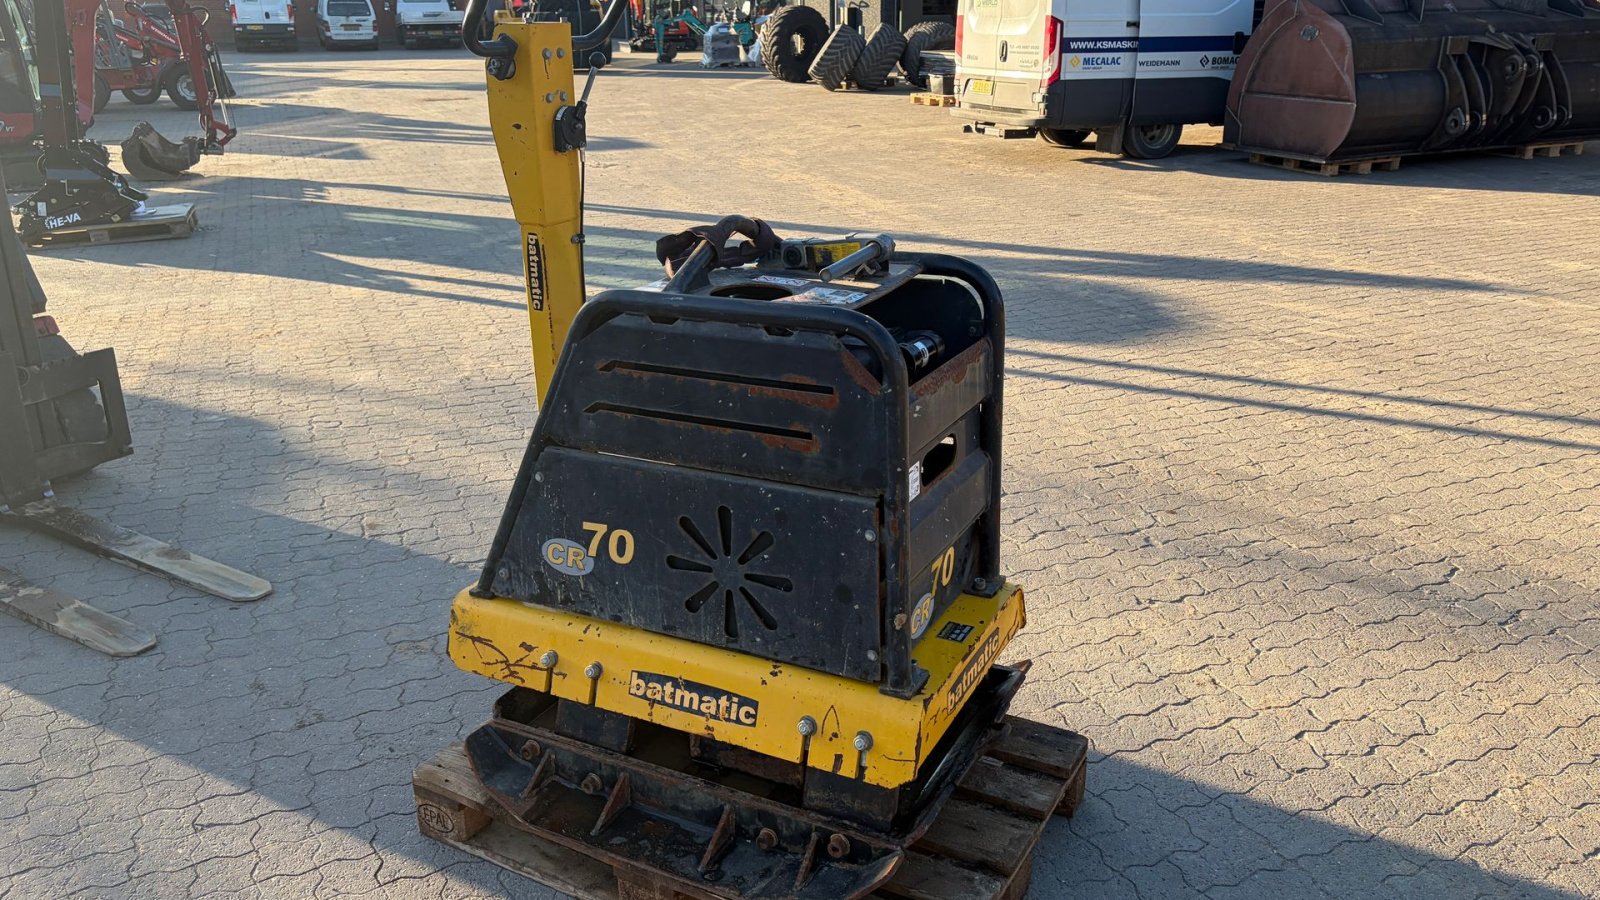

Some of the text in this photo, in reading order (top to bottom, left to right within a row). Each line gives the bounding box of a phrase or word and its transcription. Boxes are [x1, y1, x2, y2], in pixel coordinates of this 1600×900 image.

[1082, 57, 1121, 66] MECALAC
[49, 212, 81, 229] HE-VA
[528, 234, 543, 310] batmatic
[547, 521, 635, 571] CR 70
[911, 596, 932, 631] CR
[931, 546, 955, 598] 70
[629, 671, 758, 727] batmatic
[947, 633, 999, 715] batmatic
[423, 807, 450, 829] EPAL
